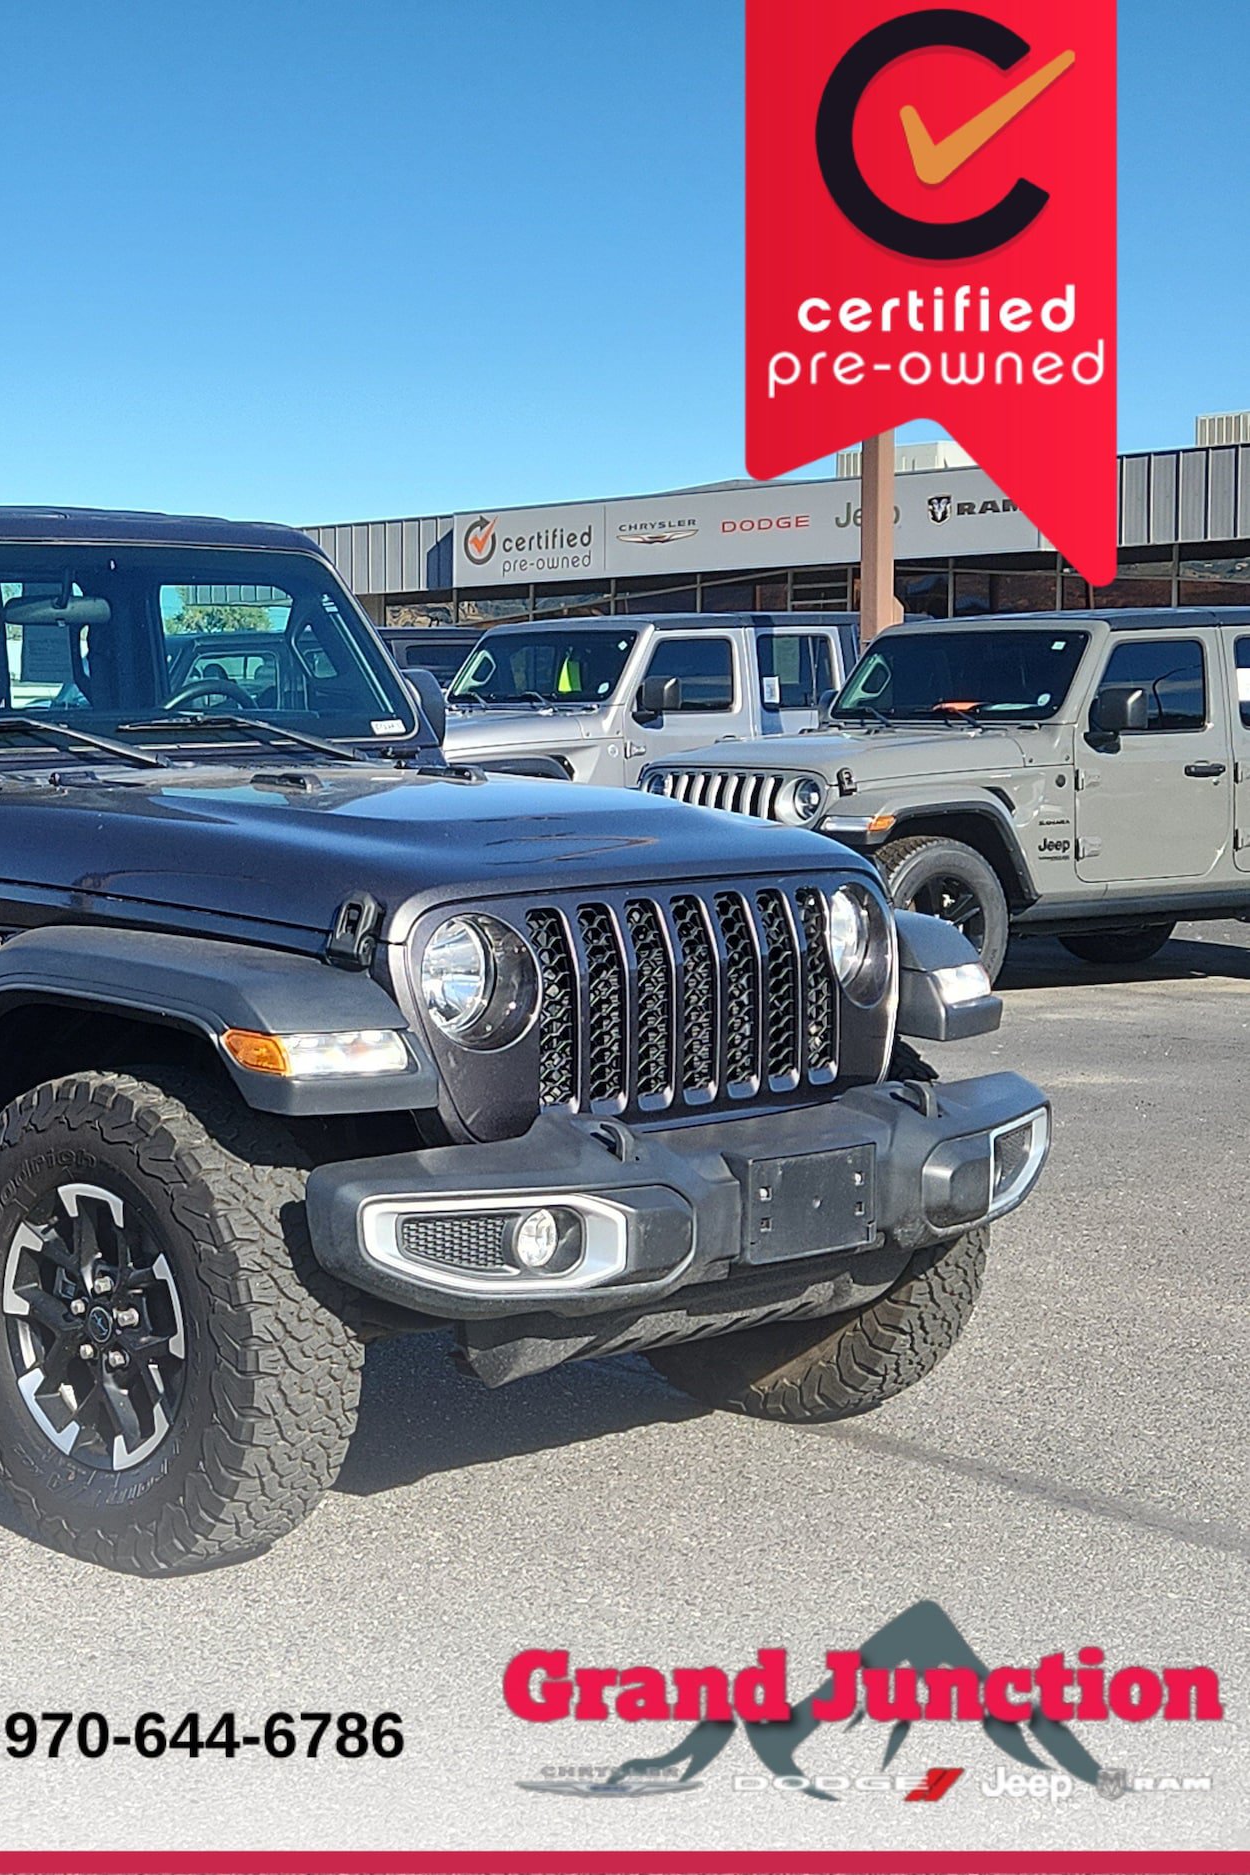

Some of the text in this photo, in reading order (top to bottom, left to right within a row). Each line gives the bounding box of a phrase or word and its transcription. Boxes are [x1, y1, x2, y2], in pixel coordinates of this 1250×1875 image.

[618, 518, 698, 532] CHRYSLER
[721, 514, 811, 533] DODGE
[502, 525, 592, 552] certified
[502, 550, 592, 578] pre-owned
[1037, 837, 1071, 853] Jeep
